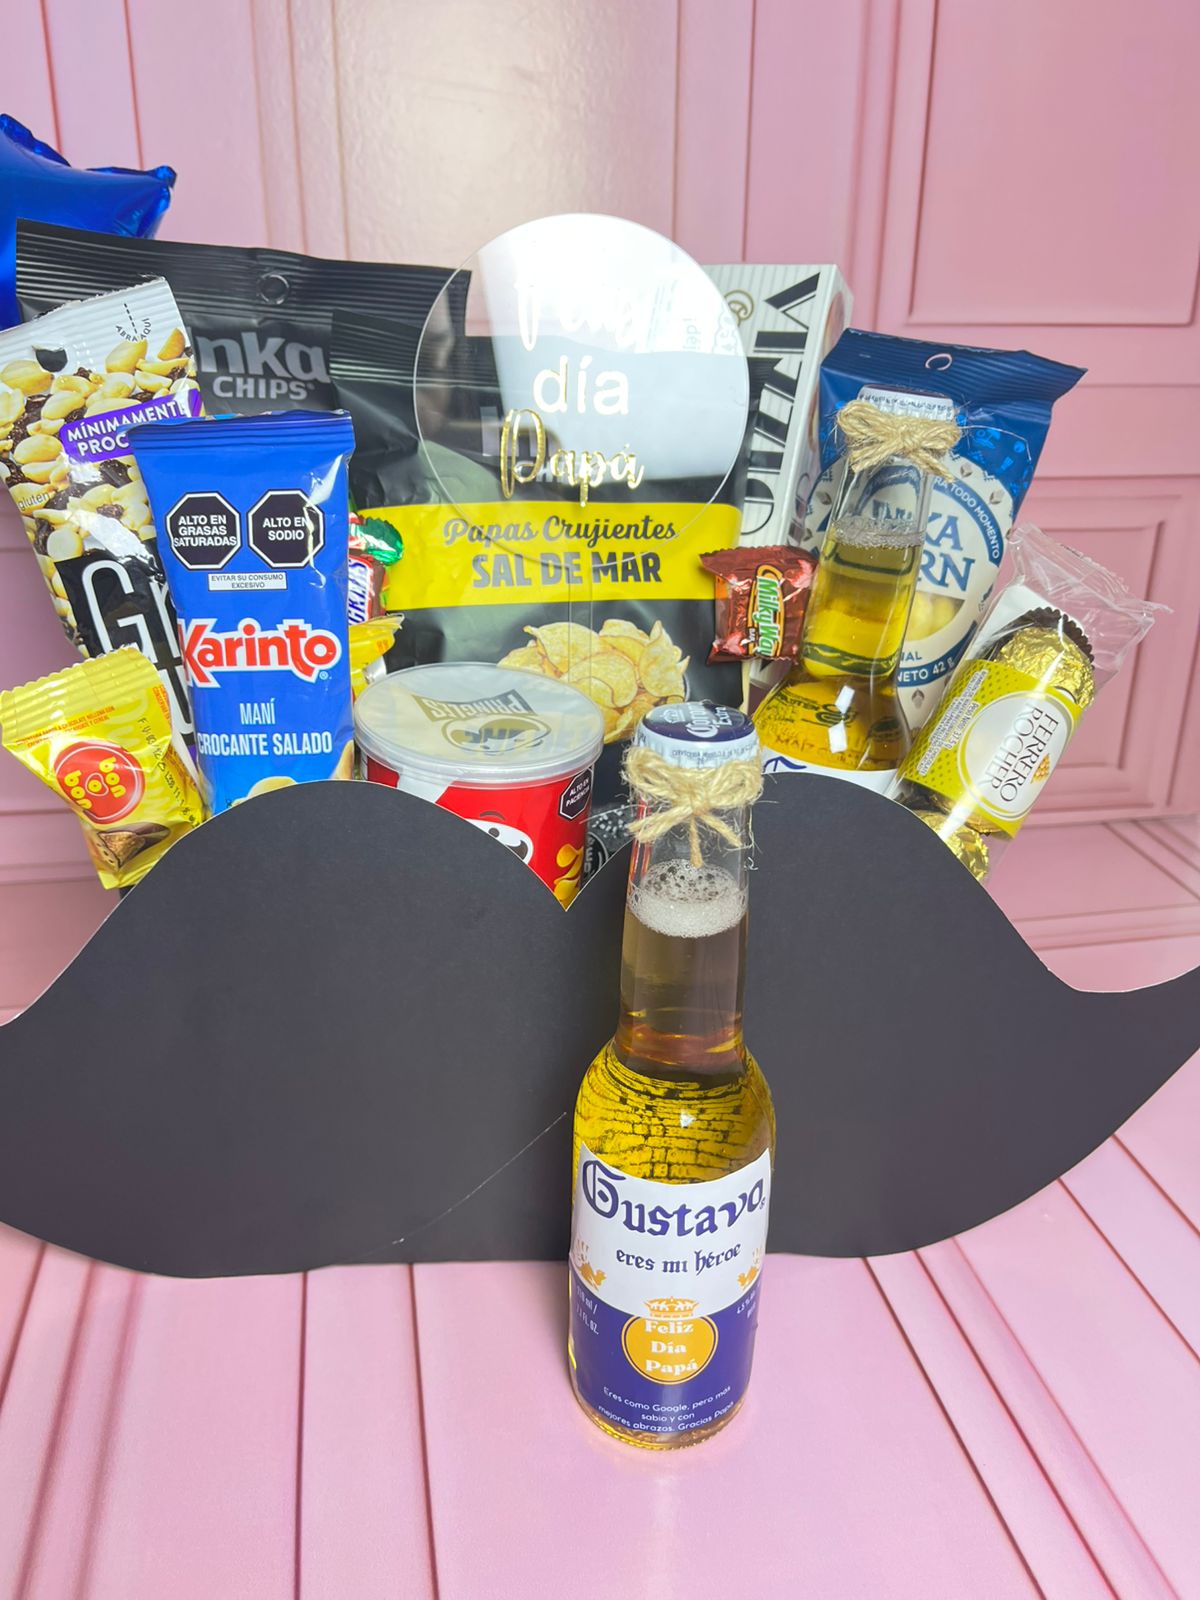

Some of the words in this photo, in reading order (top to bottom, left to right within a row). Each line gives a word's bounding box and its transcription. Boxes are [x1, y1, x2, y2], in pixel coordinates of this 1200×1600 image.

[115, 325, 138, 342] ABRA
[212, 374, 308, 401] CHIPS
[532, 354, 629, 417] día
[500, 408, 644, 507] Papá
[178, 515, 208, 526] ALTO
[210, 514, 227, 525] EN
[178, 526, 227, 536] GRASAS
[262, 517, 291, 528] ALTO
[294, 516, 308, 528] EN
[442, 517, 538, 548] Papas
[542, 515, 677, 549] Crujientes
[950, 483, 977, 508] TODO
[974, 506, 1000, 559] MOMENTO
[174, 536, 237, 548] SATURADAS
[268, 530, 305, 541] SODIO
[472, 552, 532, 588] SAL
[540, 551, 583, 586] DE
[591, 550, 663, 584] MAR
[752, 575, 780, 623] Milky
[177, 620, 340, 686] Karinto
[932, 661, 946, 675] 42
[240, 698, 276, 725] MANÍ
[421, 693, 529, 719] PRINGLES
[197, 733, 269, 756] CROCANTE
[273, 731, 332, 755] SALADO
[978, 701, 1043, 789] ROCHER
[1000, 713, 1059, 802] FERRERO
[64, 770, 93, 810] bon
[87, 779, 103, 794] o
[98, 756, 127, 799] bon
[582, 1160, 763, 1237] Gustavo
[616, 1248, 655, 1271] eres
[662, 1258, 688, 1273] mi
[694, 1243, 741, 1276] héroe
[644, 1319, 695, 1334] Feliz
[651, 1340, 687, 1354] Día
[645, 1358, 698, 1376] Papá
[603, 1386, 623, 1402] Eres
[624, 1398, 650, 1411] como
[692, 1396, 714, 1410] pero
[598, 1405, 631, 1427] mejores
[677, 1415, 712, 1431] Gracias
[641, 1412, 667, 1422] sabio
[669, 1415, 675, 1423] y
[677, 1412, 695, 1421] con
